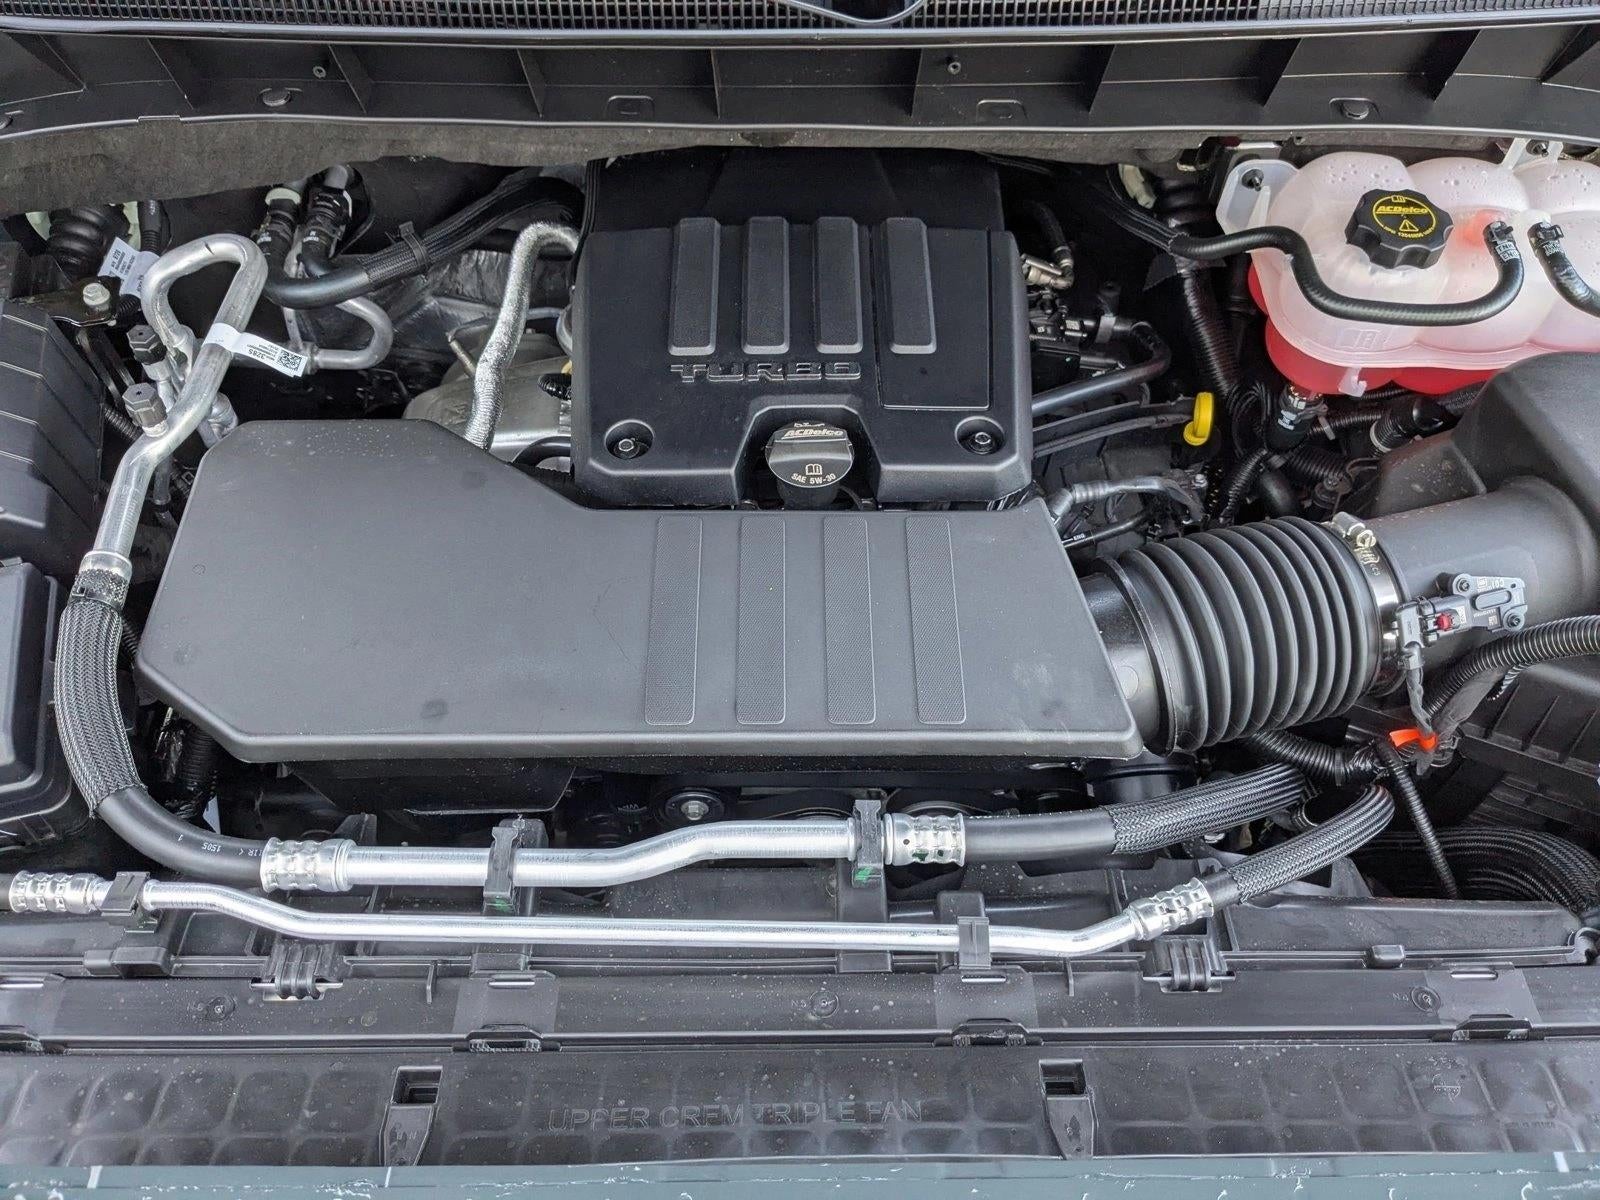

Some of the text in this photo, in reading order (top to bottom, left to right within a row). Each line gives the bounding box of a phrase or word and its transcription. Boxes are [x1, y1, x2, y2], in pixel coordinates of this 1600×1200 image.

[1376, 205, 1429, 214] ACDelco
[671, 362, 861, 383] TURBO
[781, 428, 844, 439] ACDelco
[791, 473, 836, 484] SAE 5W-30
[548, 1104, 650, 1132] UPPER
[751, 1101, 857, 1126] TRIPLE
[865, 1099, 924, 1125] FAN
